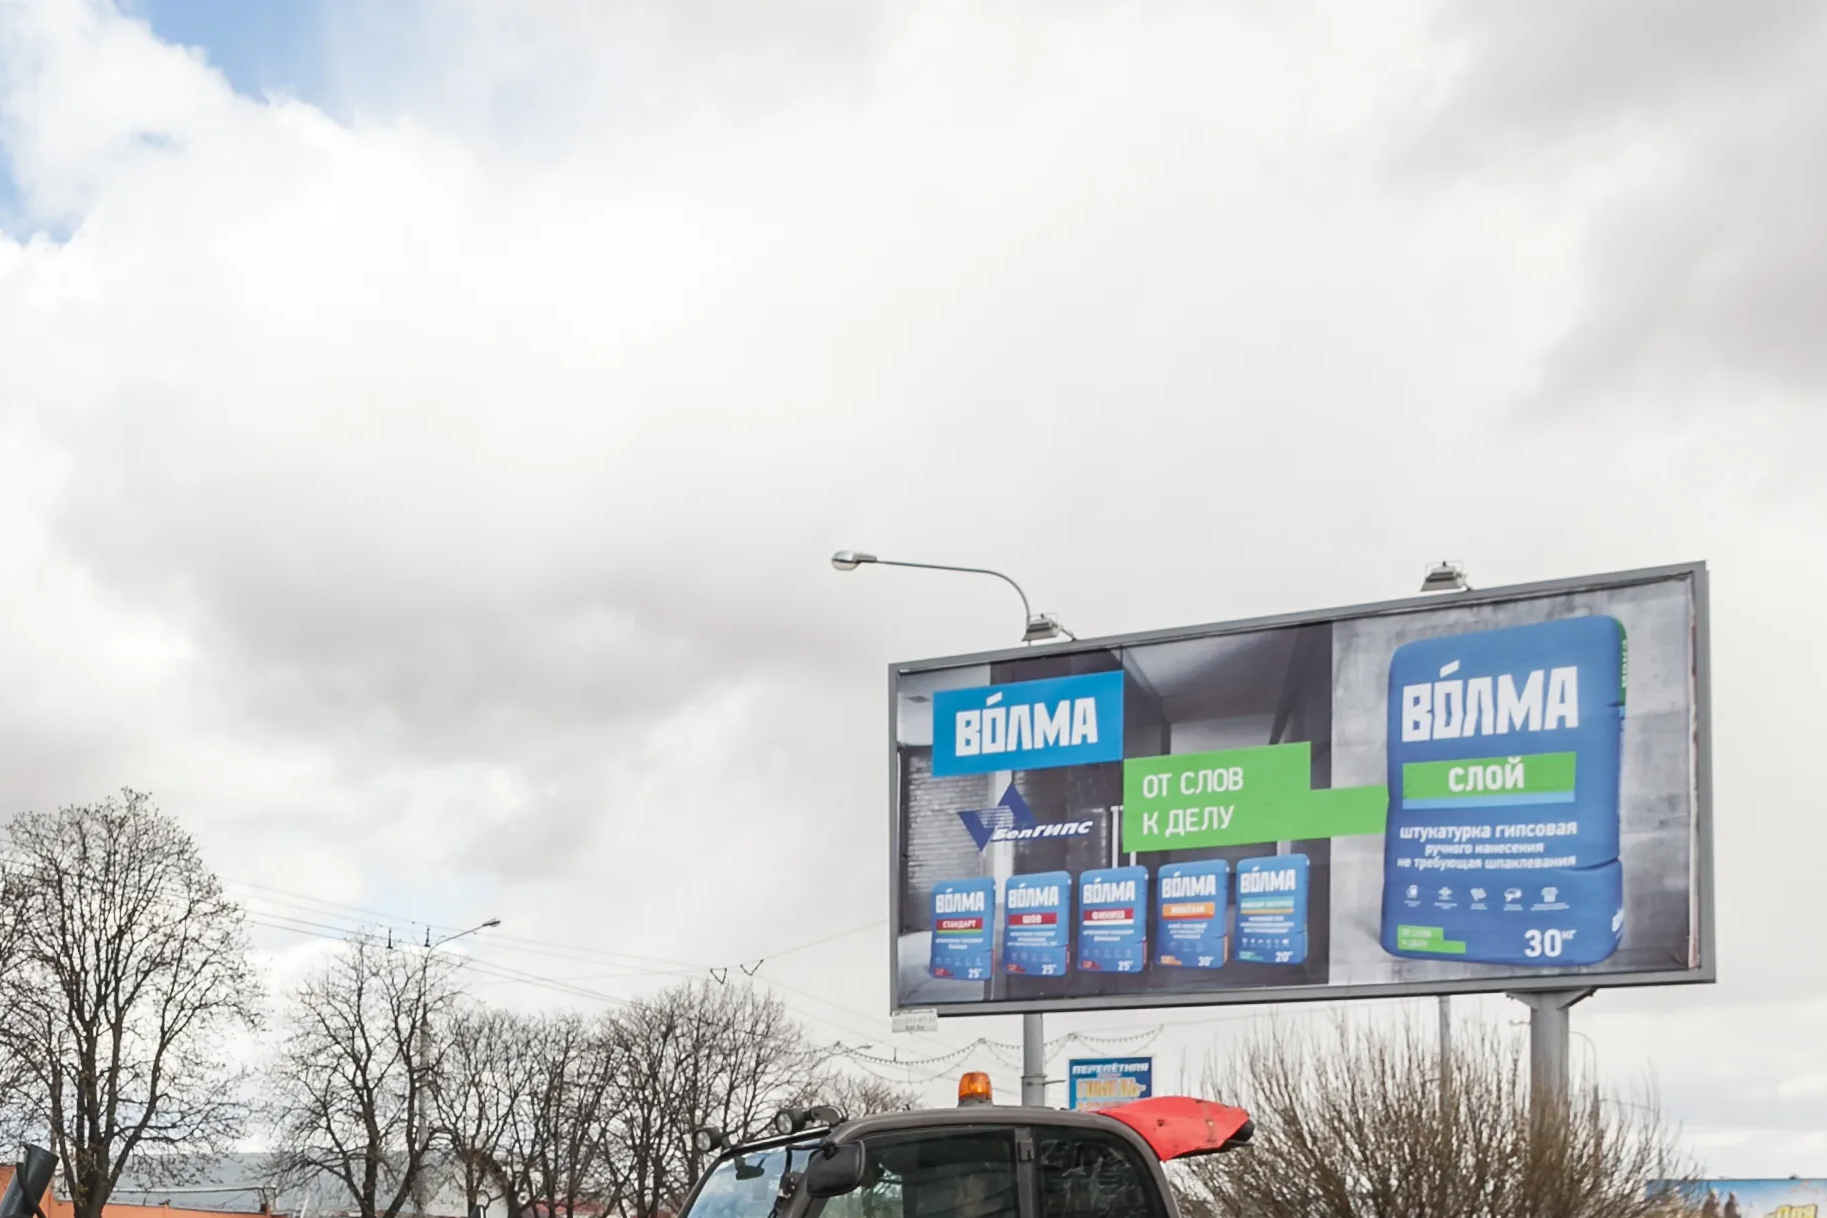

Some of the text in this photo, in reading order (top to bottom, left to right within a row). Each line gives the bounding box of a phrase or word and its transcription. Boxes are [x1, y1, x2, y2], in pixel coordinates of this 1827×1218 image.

[1142, 766, 1244, 798] ОТ СЛОВ
[1448, 756, 1525, 792] СЛОЙ
[1142, 805, 1235, 837] К ДЕЛУ
[1399, 821, 1578, 843] штукатурка гипсовая
[1414, 856, 1483, 870] требующая
[1484, 855, 1577, 870] шпаклевания
[1424, 842, 1544, 857] ручного нанесения
